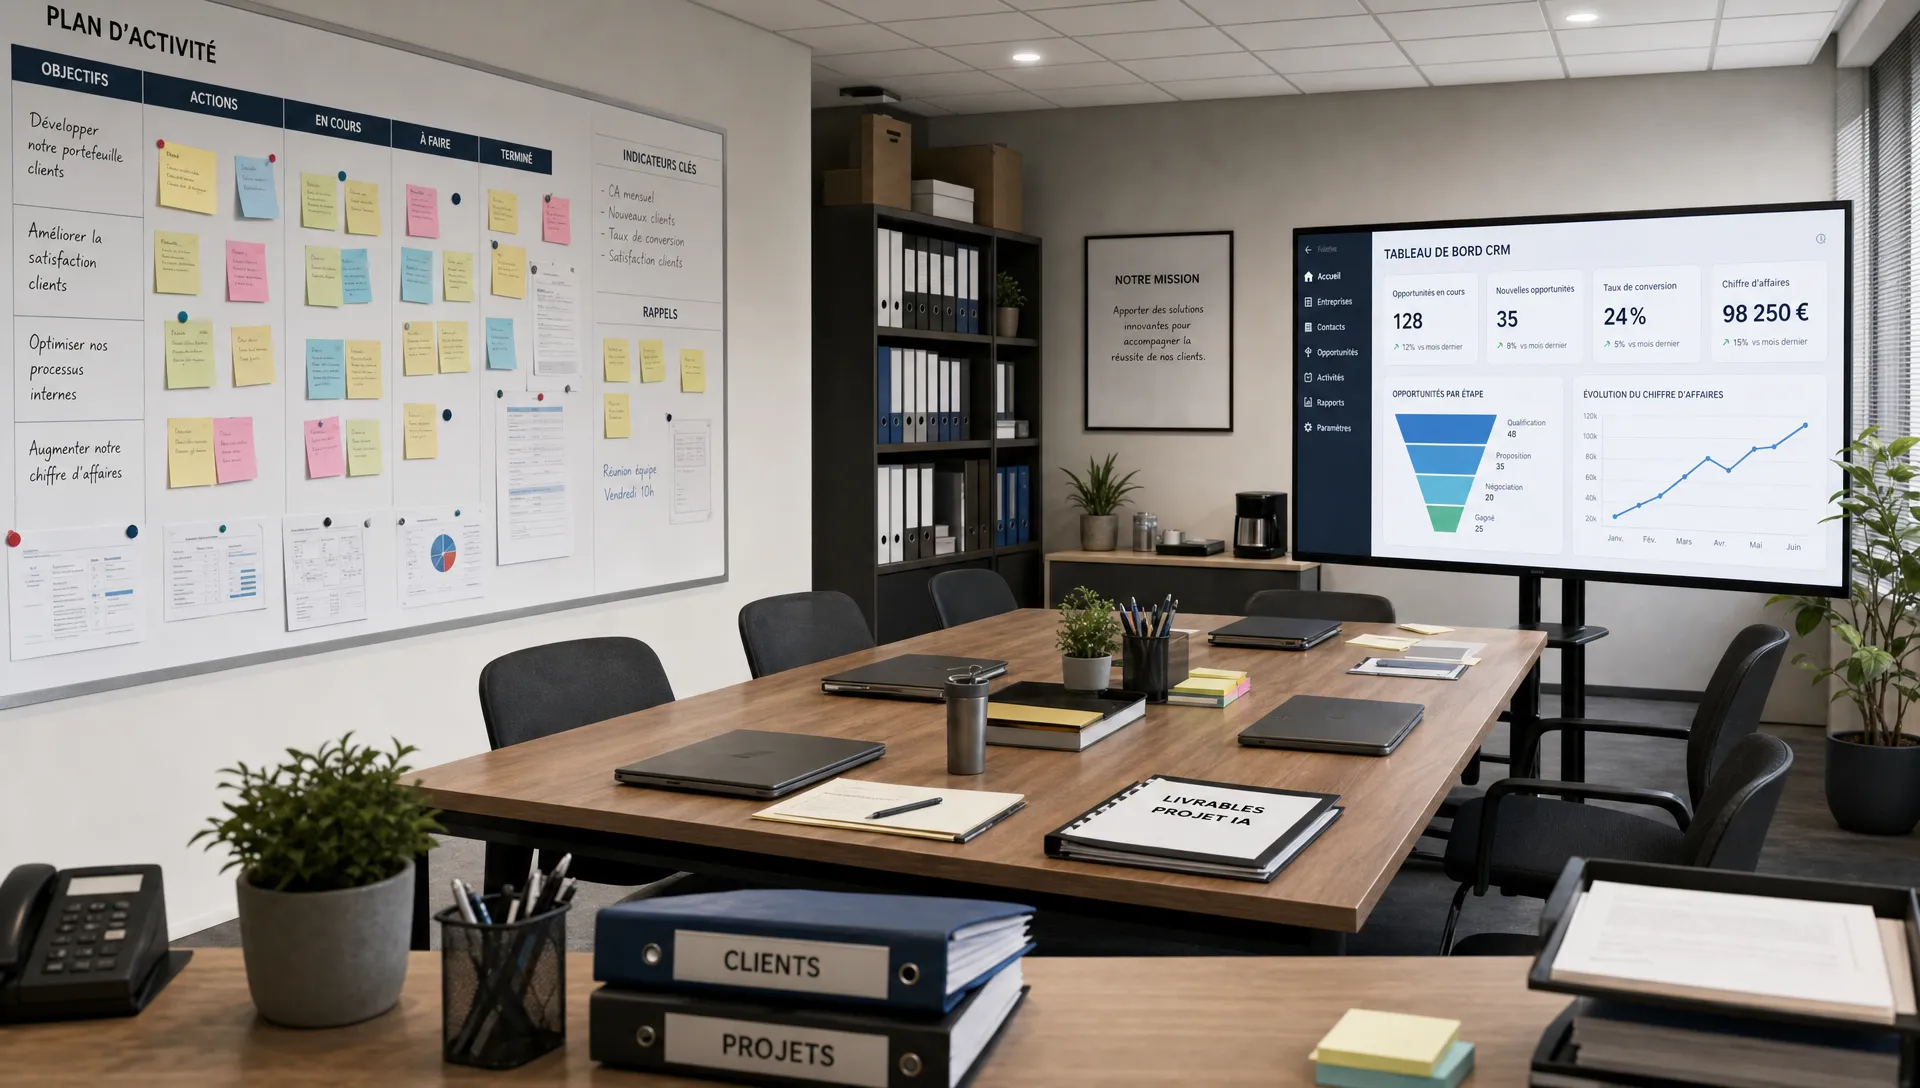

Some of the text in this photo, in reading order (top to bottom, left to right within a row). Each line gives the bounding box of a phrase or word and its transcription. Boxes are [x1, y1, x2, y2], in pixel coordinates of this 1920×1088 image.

[47, 5, 101, 37] PLAN
[41, 61, 109, 87] OBJECTIFS
[190, 91, 238, 110] ACTIONS
[29, 111, 99, 140] Développer
[316, 114, 362, 133] EN COURS
[420, 131, 451, 150] À FAIRE
[28, 138, 123, 163] notre portefeuille
[501, 149, 533, 164] TERMINÉ
[623, 149, 697, 175] INDICATEURS CLÉS
[28, 161, 65, 178] clients
[609, 184, 654, 203] CA mensuel
[609, 206, 675, 226] Nouveaux clients
[28, 221, 102, 244] Améliorer la
[608, 227, 684, 246] Taux de conversion
[1384, 244, 1510, 259] TABLEAU DE BORD CRM
[29, 250, 97, 269] satisfaction
[609, 249, 683, 268] Satisfaction clients
[1115, 274, 1199, 285] NOTRE MISSION
[1317, 272, 1341, 280] Accueil
[28, 276, 67, 292] clients
[1603, 282, 1677, 292] Taux de conversion
[1722, 278, 1790, 289] Chiffre d'affaires
[1392, 288, 1435, 299] Opportunités
[1496, 285, 1575, 295] Nouvelles opportunités
[1317, 297, 1353, 307] Entreprises
[643, 306, 678, 320] RAPPELS
[1113, 304, 1204, 318] Apporter des solutions
[1394, 312, 1423, 329] 128
[1497, 310, 1518, 328] 35
[1124, 321, 1191, 333] innovantes pour
[1317, 323, 1346, 331] Contacts
[29, 333, 108, 356] Optimiser nos
[1123, 336, 1191, 349] accompagner la
[1402, 343, 1415, 351] 12%
[1507, 342, 1517, 350] 8%
[1614, 340, 1625, 348] 5%
[1733, 338, 1748, 346] 15%
[1781, 338, 1808, 346] dernier
[1111, 352, 1144, 362] réussite
[1147, 352, 1157, 361] de
[1177, 351, 1205, 361] clients.
[1317, 348, 1358, 358] Opportunités
[30, 363, 84, 380] processus
[1317, 373, 1344, 381] Activités
[30, 386, 77, 401] internes
[1392, 389, 1483, 398] OPPORTUNITÉS PAR ÉTAPE
[1583, 389, 1724, 399] ÉVOLUTION DU CHIFFRE D'AFFAIRES
[1317, 399, 1345, 408] Rapports
[1583, 412, 1598, 420] 120k
[1317, 424, 1352, 432] Paramètres
[1507, 419, 1546, 427] Qualification
[1507, 430, 1517, 438] 48
[1583, 432, 1598, 440] 100k
[29, 440, 121, 461] Augmenter notre
[1496, 451, 1532, 460] Proposition
[603, 463, 657, 480] Réunion équipe
[1496, 462, 1505, 470] 35
[29, 463, 122, 486] chiffre d'affaires
[604, 484, 654, 501] Vendredi 10h
[1485, 483, 1523, 492] Négociation
[1485, 493, 1494, 501] 20
[1475, 514, 1495, 523] Gagné
[1475, 525, 1484, 533] 25
[1608, 534, 1623, 542] Janv.
[1643, 535, 1656, 543] Fév.
[1676, 537, 1692, 545] Mars
[1750, 541, 1762, 549] Mai
[1786, 543, 1801, 551] Juin
[1162, 795, 1265, 815] LIVRABLES
[1151, 806, 1250, 826] PROJET IA
[724, 950, 820, 978] CLIENTS
[723, 1033, 834, 1067] PROJETS
